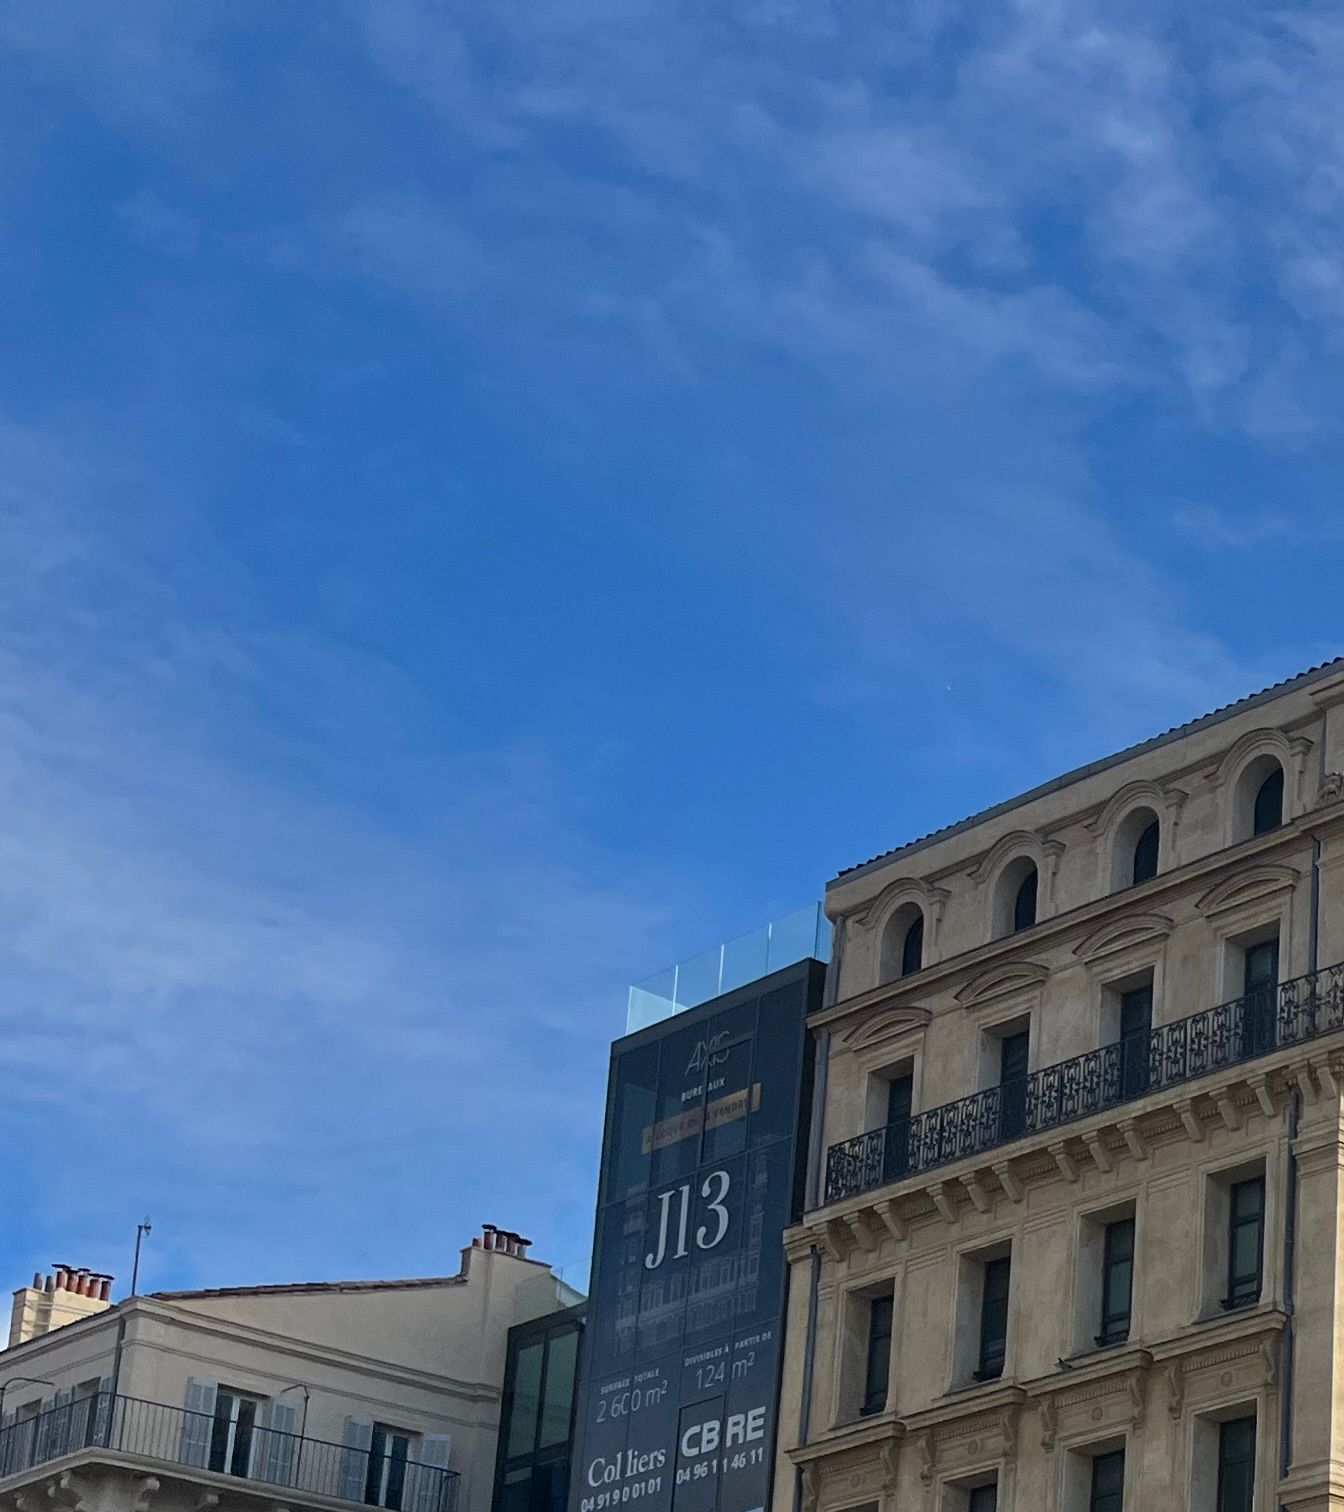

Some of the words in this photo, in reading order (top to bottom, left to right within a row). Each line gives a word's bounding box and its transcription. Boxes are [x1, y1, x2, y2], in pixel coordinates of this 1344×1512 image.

[734, 1337, 761, 1351] PARTIR
[762, 1331, 772, 1343] DE
[696, 1361, 725, 1390] 124
[681, 1406, 766, 1458] CBRE
[588, 1448, 667, 1488] Colliers
